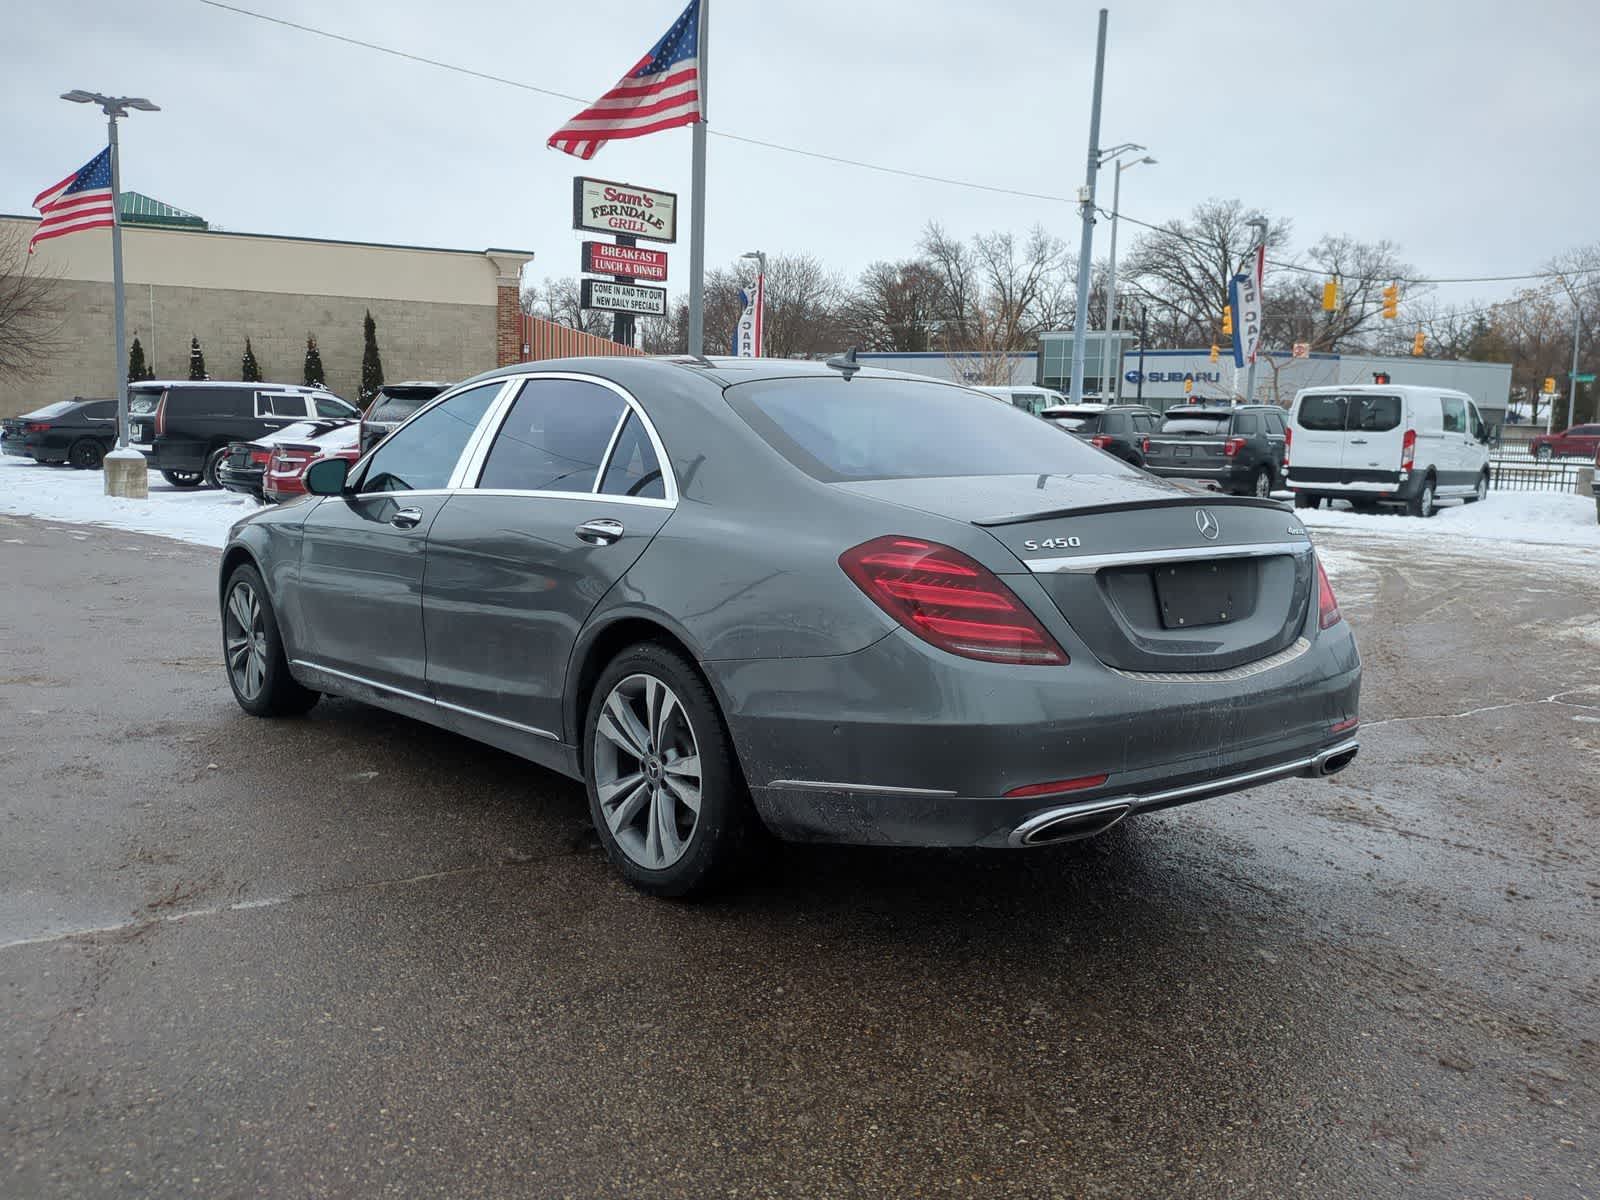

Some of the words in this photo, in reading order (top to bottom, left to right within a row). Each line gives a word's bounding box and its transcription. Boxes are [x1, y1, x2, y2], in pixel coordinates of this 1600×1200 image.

[603, 187, 654, 208] Sam's
[591, 205, 665, 230] FERNDALE
[608, 217, 648, 233] GRILL
[601, 245, 657, 263] BREAKFAST
[595, 259, 623, 272] LUNCH
[624, 263, 632, 273] &
[633, 264, 663, 277] DINNER
[593, 284, 612, 294] COME
[613, 286, 621, 296] IN
[622, 287, 635, 297] AND
[636, 289, 648, 299] TRY
[649, 290, 662, 300] OUR
[596, 296, 612, 306] NEW
[612, 297, 630, 309] DAILY
[630, 300, 660, 311] SPECIALS
[1148, 371, 1220, 382] SUBARU
[1023, 539, 1038, 551] S
[1041, 536, 1081, 549] 450
